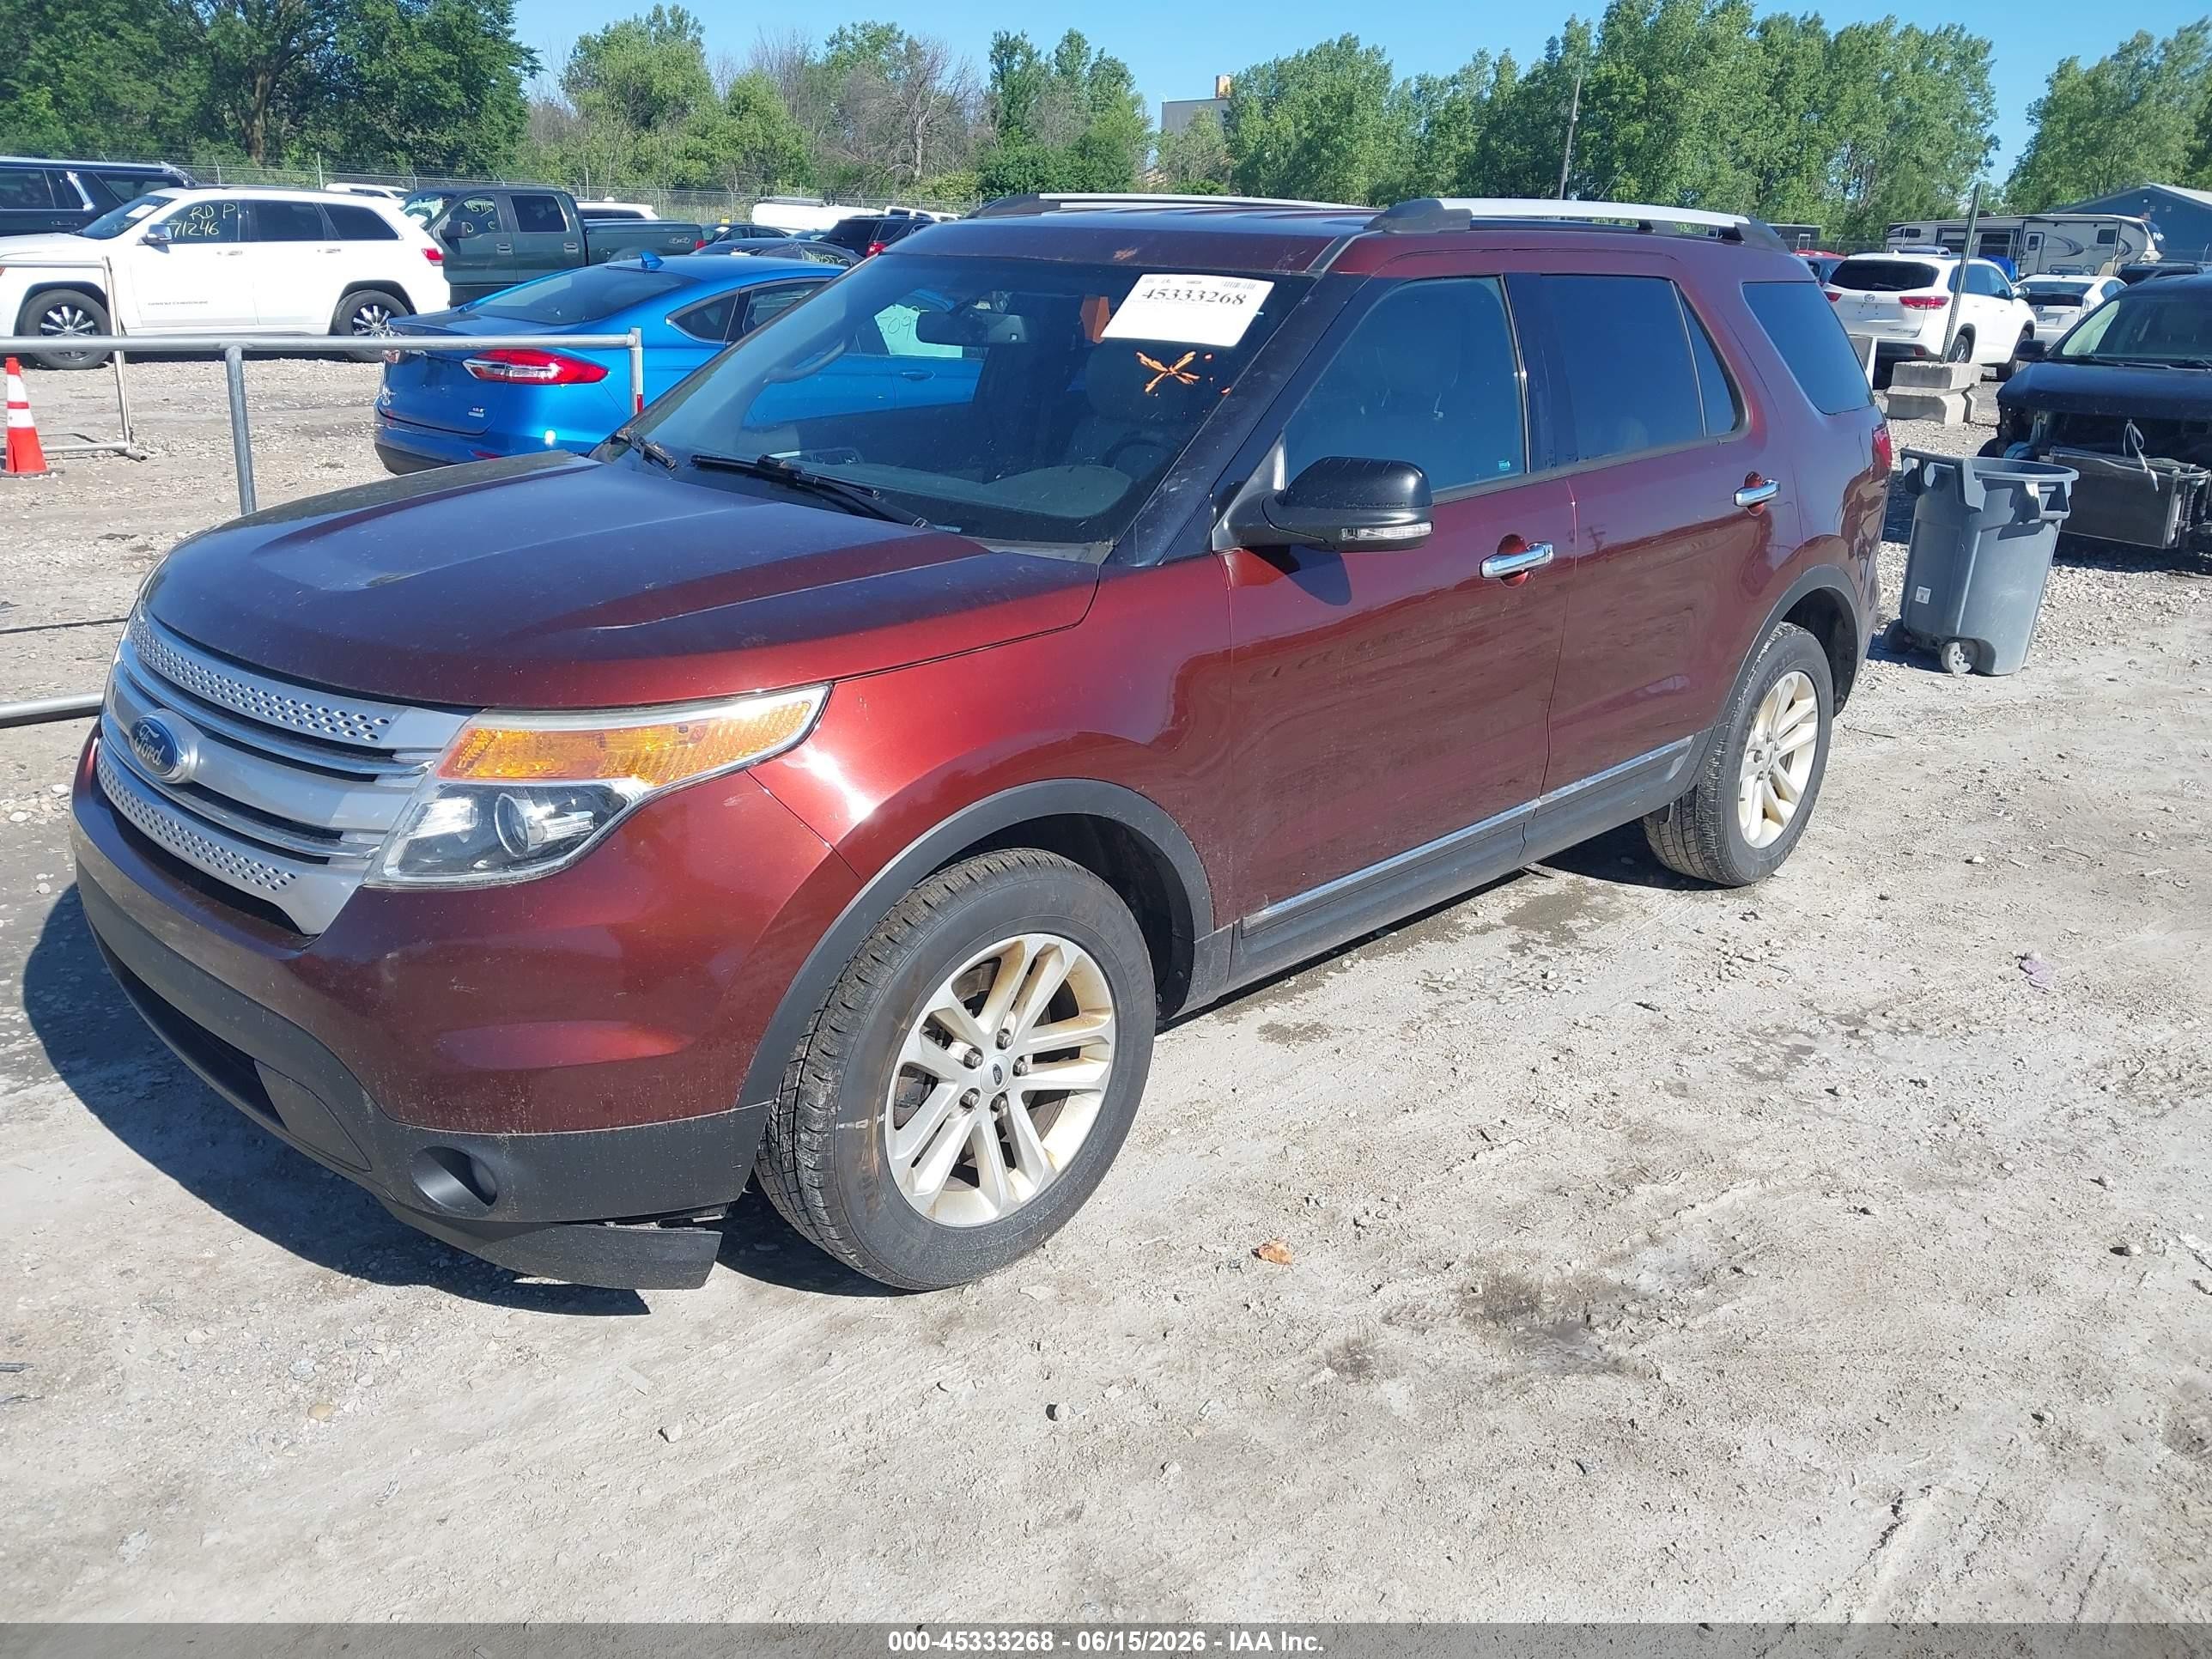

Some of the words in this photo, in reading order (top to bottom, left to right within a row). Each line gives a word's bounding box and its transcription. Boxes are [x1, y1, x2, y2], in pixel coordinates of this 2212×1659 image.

[190, 204, 214, 221] RD
[222, 204, 236, 220] P
[167, 220, 220, 238] 71246
[1141, 289, 1247, 306] 45333268
[134, 725, 166, 766] Ford
